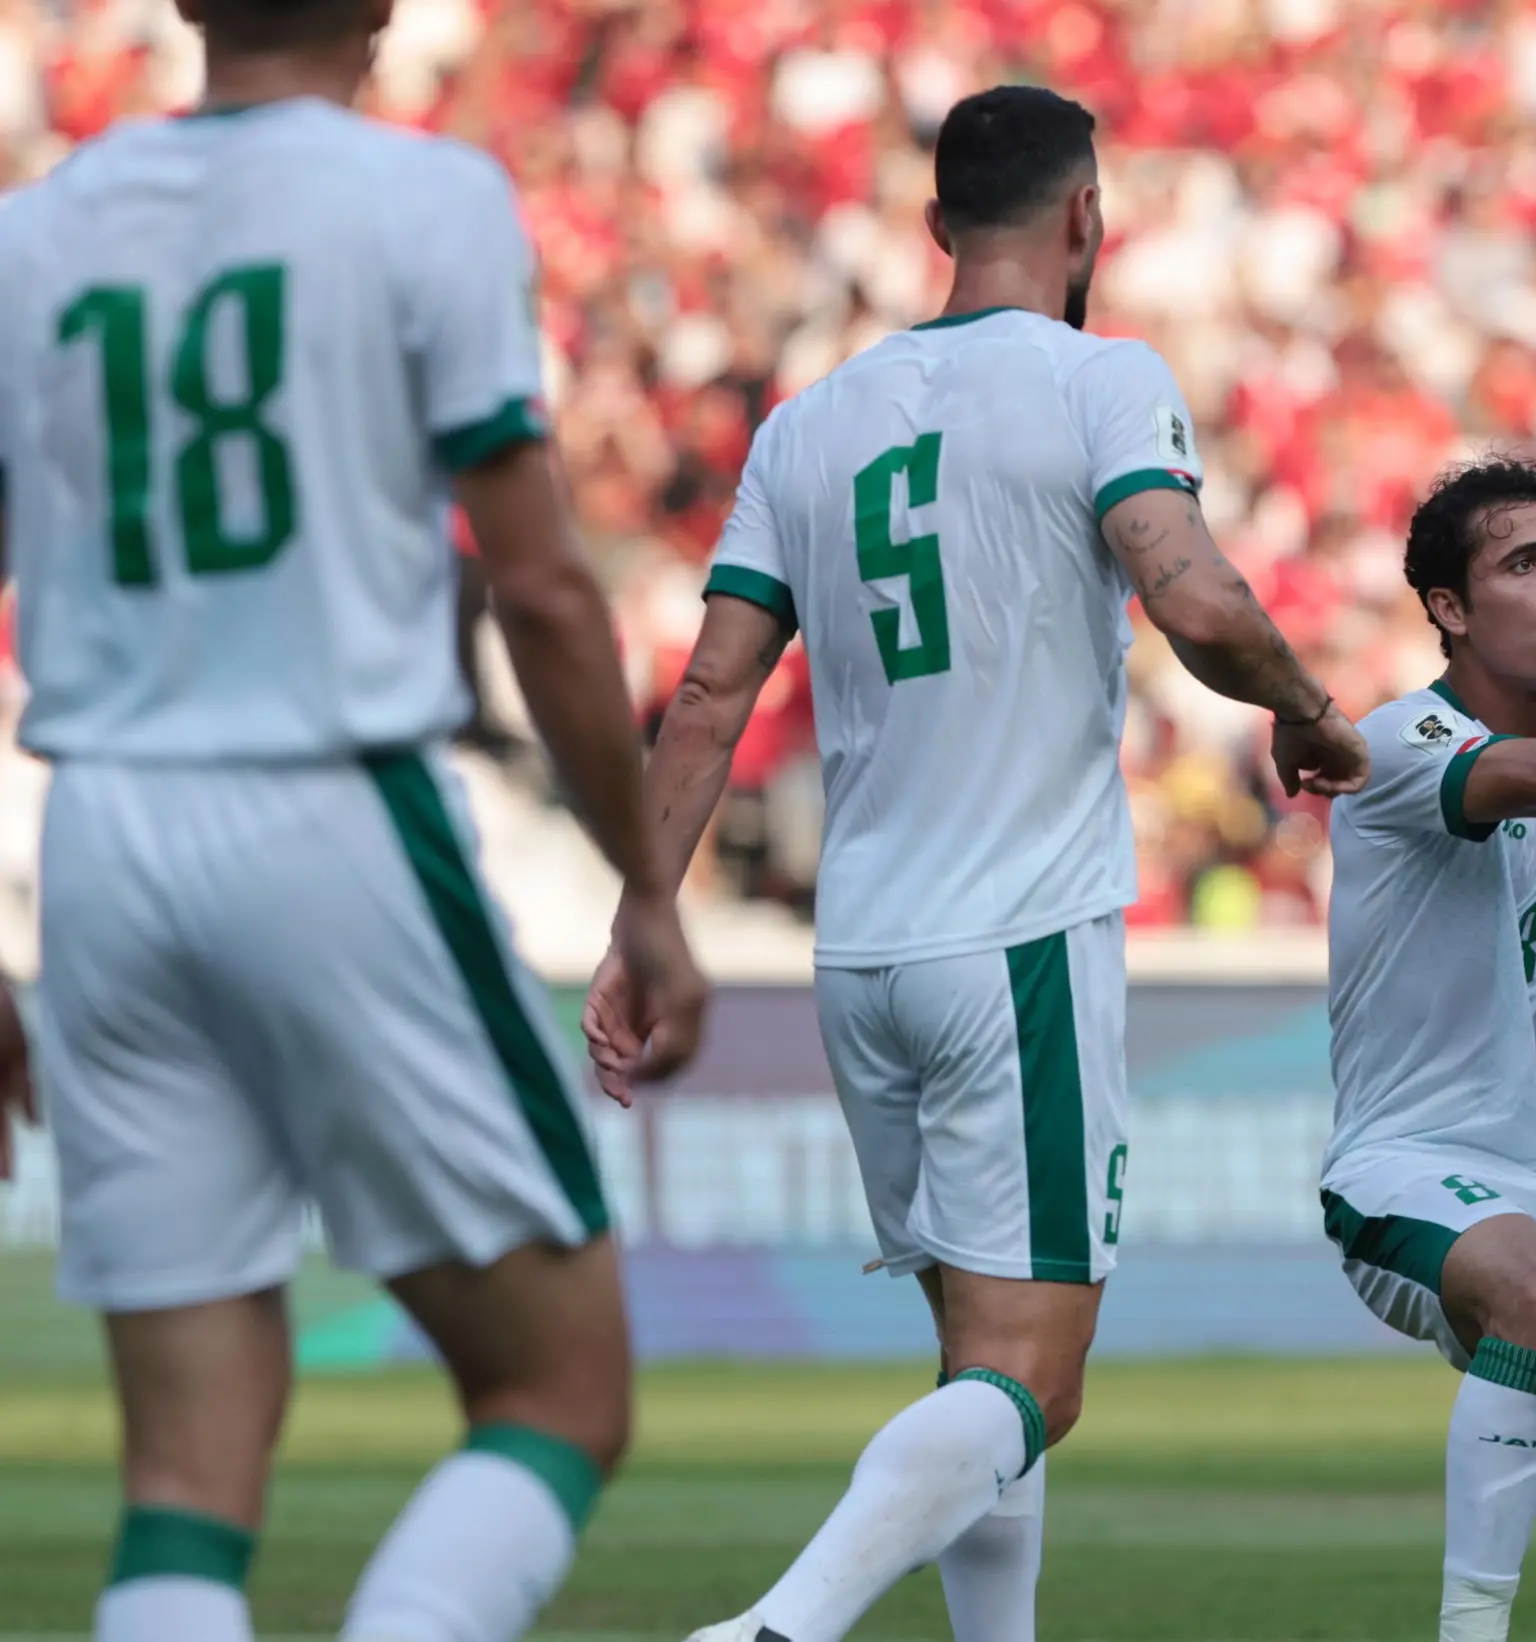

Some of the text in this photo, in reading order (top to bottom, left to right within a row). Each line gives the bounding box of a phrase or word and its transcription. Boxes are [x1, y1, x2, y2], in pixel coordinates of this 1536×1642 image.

[58, 258, 301, 591] 18
[853, 431, 952, 687] 5
[1103, 1144, 1128, 1244] 5
[1440, 1174, 1502, 1206] 8
